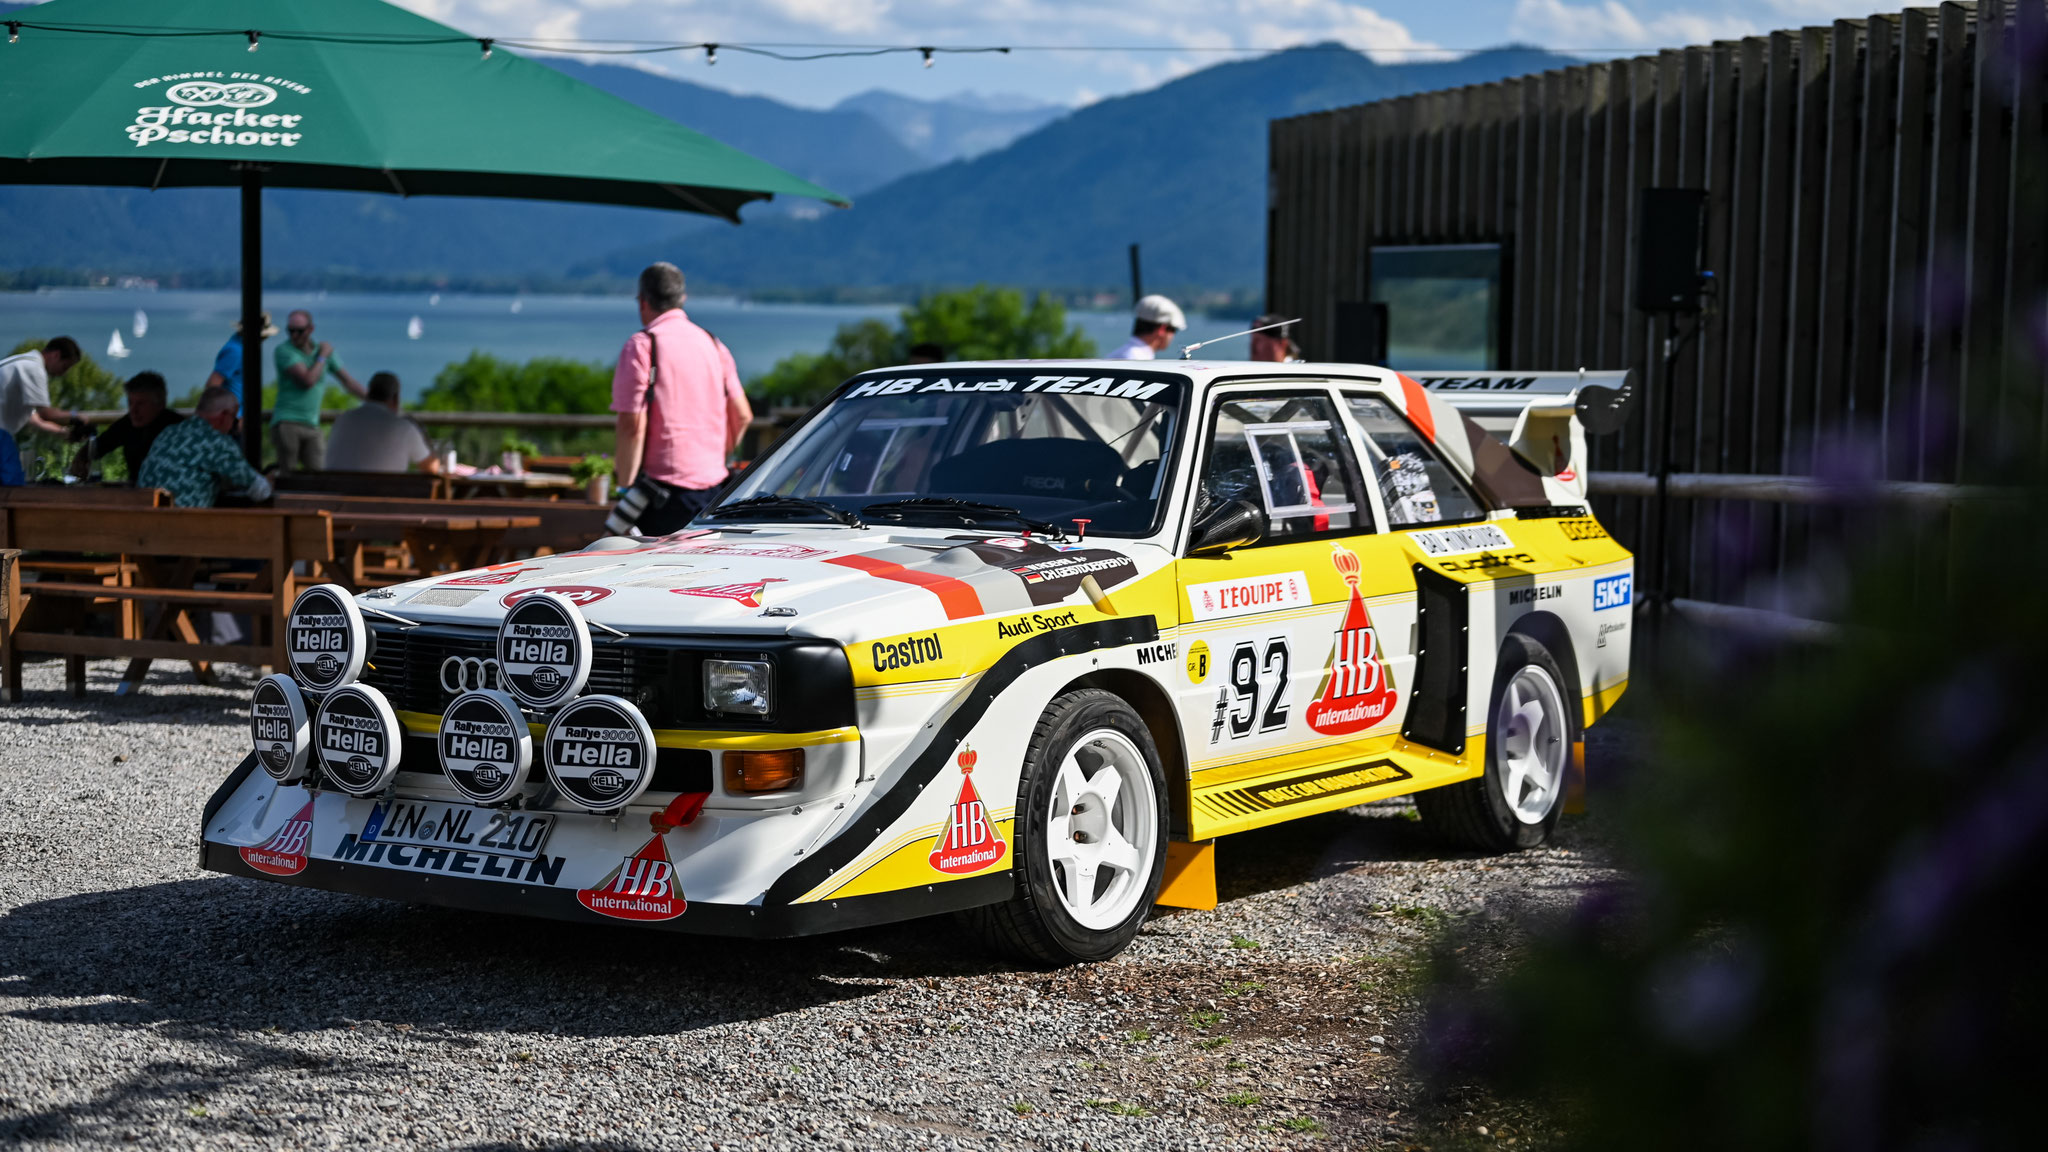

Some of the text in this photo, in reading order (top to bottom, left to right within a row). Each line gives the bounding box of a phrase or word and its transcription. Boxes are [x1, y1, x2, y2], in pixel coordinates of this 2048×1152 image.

[135, 106, 303, 128] Hacker
[125, 123, 303, 148] Pschorr
[844, 375, 1170, 400] HB Audi TEAM
[1421, 377, 1538, 390] TEAM
[1509, 585, 1563, 605] MICHELIN
[1595, 576, 1631, 608] SKF
[298, 615, 345, 627] Rallye 3000
[513, 624, 571, 638] Rallye 3000
[997, 611, 1080, 640] Audi Sport
[296, 629, 343, 650] Hella
[509, 639, 567, 663] Hella
[871, 632, 943, 673] Castrol
[316, 657, 338, 672] HELLA
[1333, 626, 1380, 700] HB
[532, 673, 561, 685] HELLA
[272, 705, 289, 717] 3000
[329, 713, 380, 731] Rallye 3000
[1315, 700, 1386, 728] international
[257, 718, 289, 740] Hella
[453, 720, 510, 736] Rallye 3000
[565, 727, 636, 742] Rallye 3000
[326, 727, 378, 754] Hella
[450, 735, 508, 760] Hella
[560, 742, 633, 767] Hella
[348, 761, 372, 775] HELLA
[475, 768, 502, 782] HELLA
[590, 775, 625, 790] HELLA
[381, 803, 548, 853] IN NL 210
[948, 799, 987, 850] HB
[263, 818, 313, 855] HB
[248, 849, 298, 870] international
[332, 833, 567, 886] MICHELIN
[939, 846, 997, 869] international
[612, 855, 674, 898] HB
[591, 893, 672, 914] international
